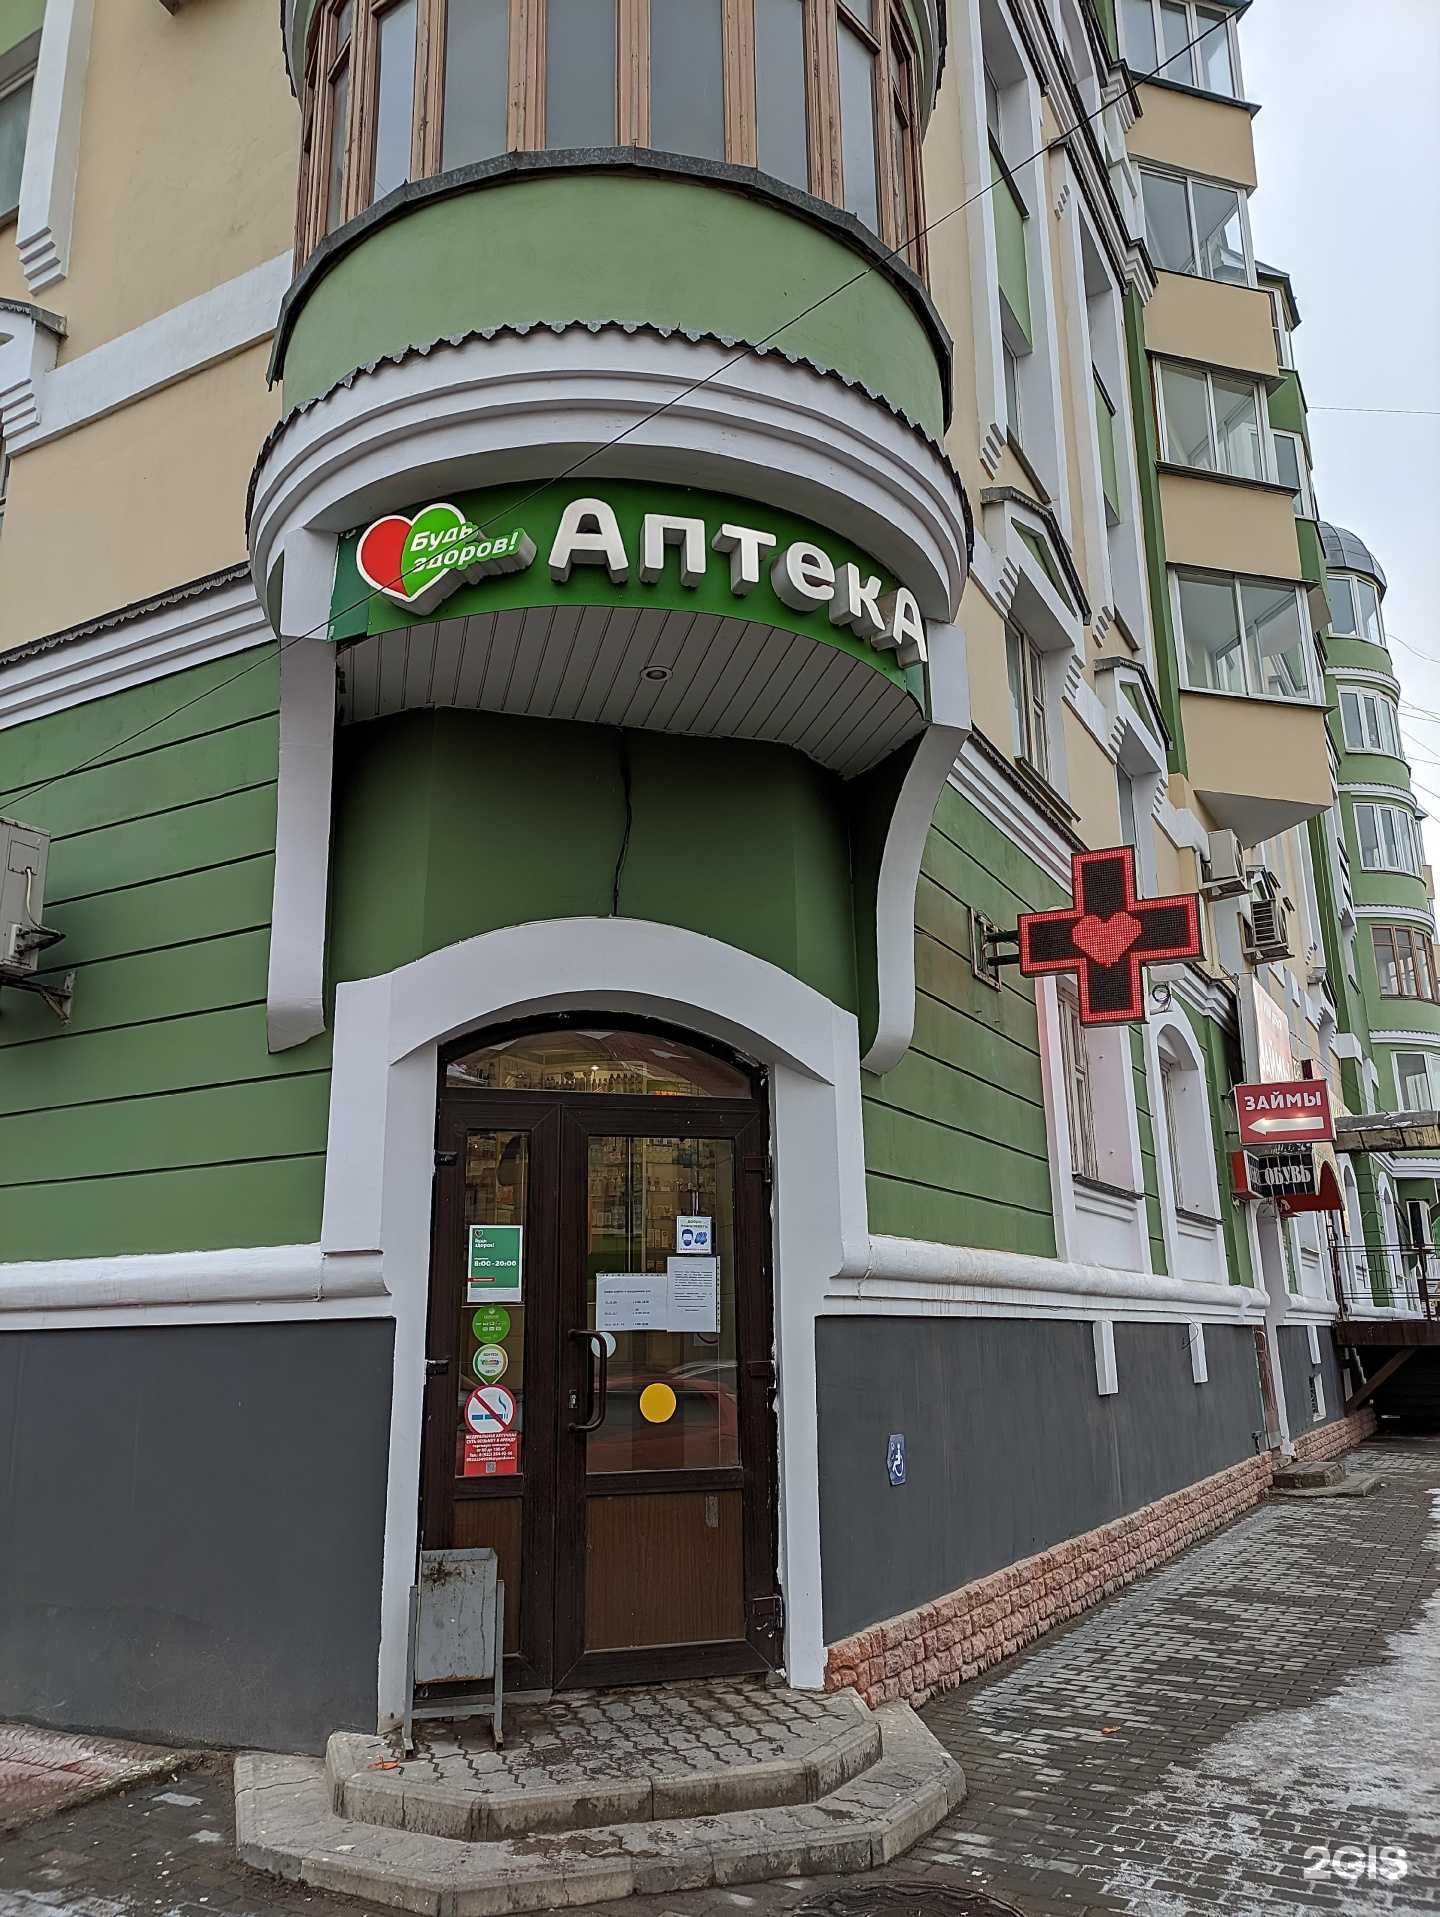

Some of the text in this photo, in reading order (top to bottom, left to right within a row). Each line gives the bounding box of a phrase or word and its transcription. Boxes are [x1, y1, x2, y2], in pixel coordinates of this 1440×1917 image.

[410, 525, 477, 552] Будь
[412, 531, 519, 573] здоров!
[1244, 1091, 1322, 1111] ЗАЙМЫ
[1264, 1165, 1311, 1185] ОБУВЬ
